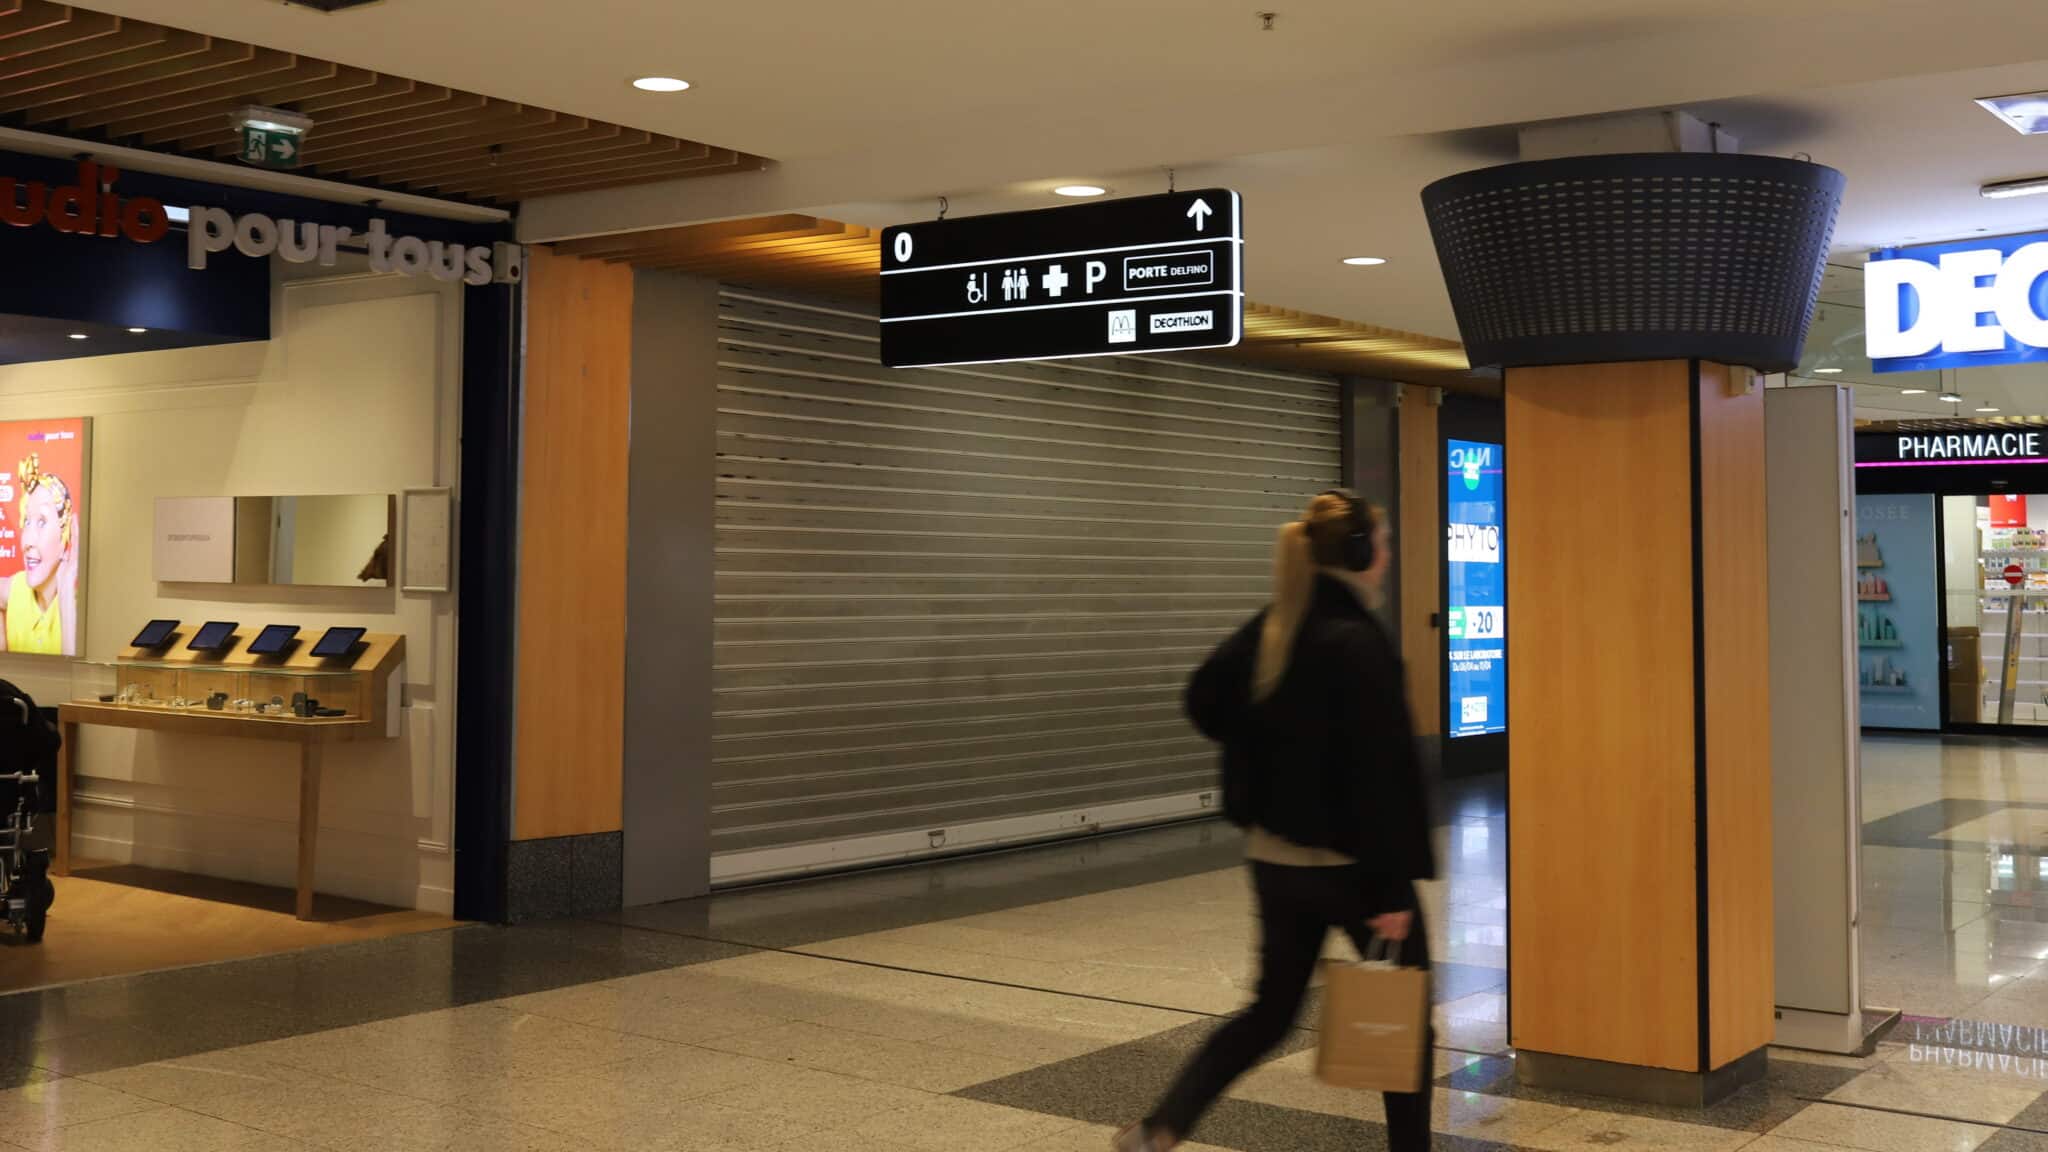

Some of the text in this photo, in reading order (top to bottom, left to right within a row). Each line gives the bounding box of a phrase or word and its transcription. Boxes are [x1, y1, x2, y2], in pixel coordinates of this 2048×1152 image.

[188, 203, 351, 270] pour
[364, 218, 493, 286] tous
[894, 231, 913, 263] 0
[1086, 261, 1106, 294] P
[1129, 264, 1208, 280] PORTE DELFINO
[1154, 315, 1209, 329] DECATHLON
[1898, 433, 2040, 459] PHARMACIE
